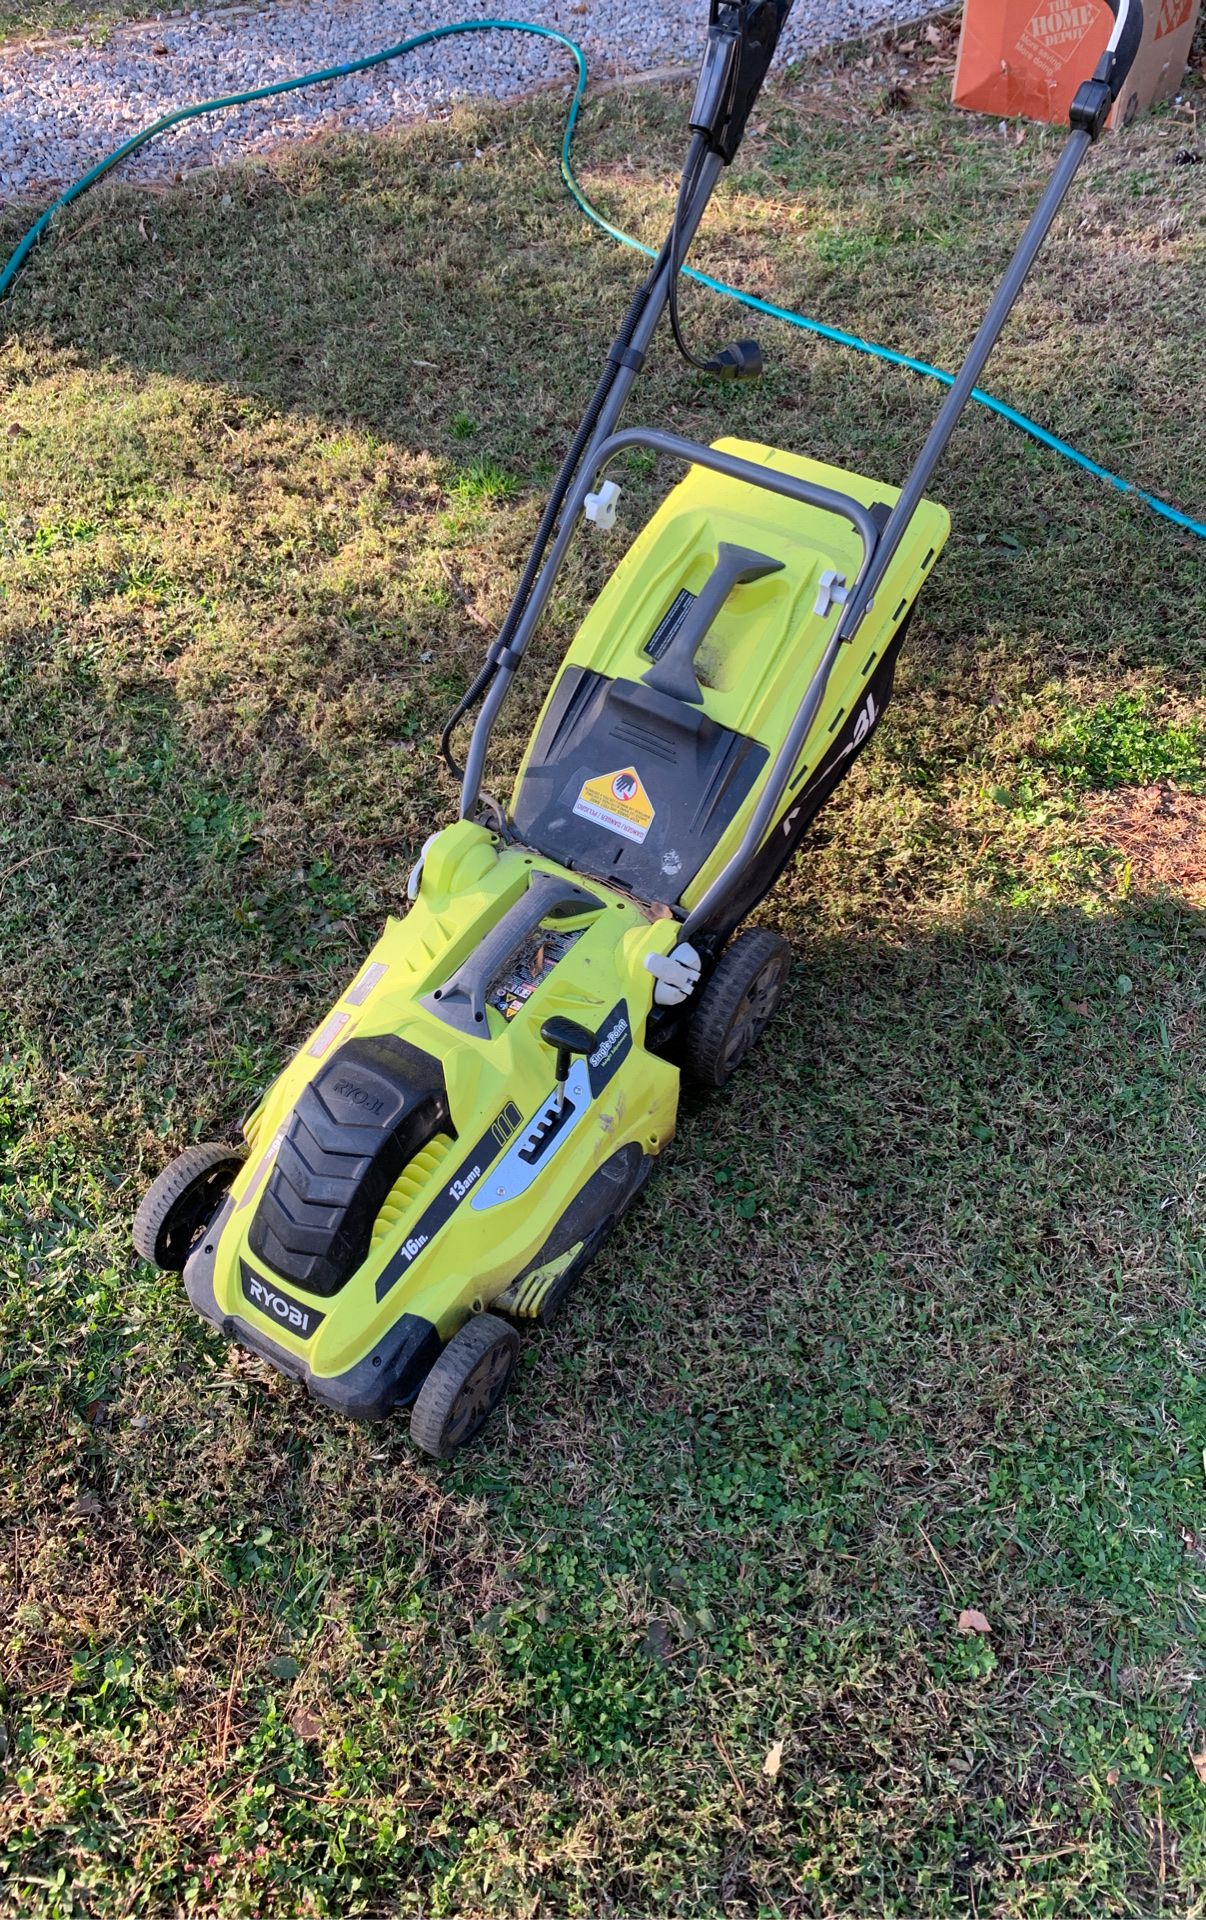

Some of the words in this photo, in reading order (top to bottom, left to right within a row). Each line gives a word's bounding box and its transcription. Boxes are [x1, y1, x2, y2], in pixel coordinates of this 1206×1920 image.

[1031, 3, 1095, 38] HOME
[1045, 27, 1085, 47] DEPOT
[333, 1079, 385, 1115] RYOBI
[250, 1277, 309, 1331] RYOBI
